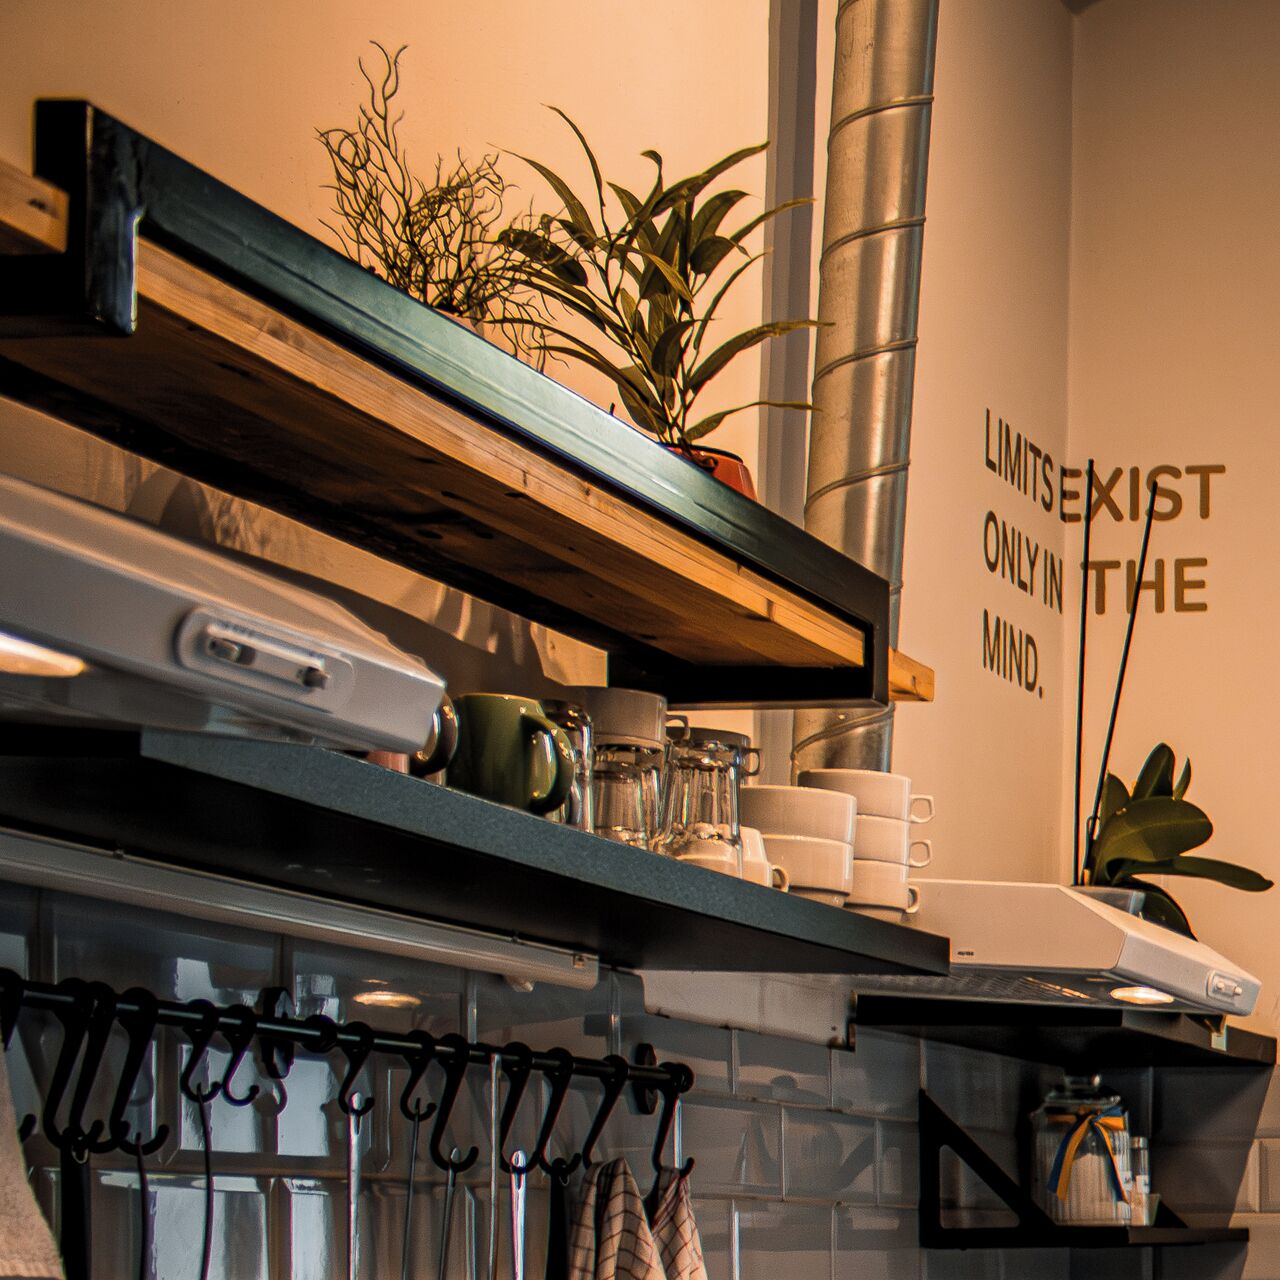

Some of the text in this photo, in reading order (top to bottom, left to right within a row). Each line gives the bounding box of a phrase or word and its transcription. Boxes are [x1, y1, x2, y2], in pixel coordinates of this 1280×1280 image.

[985, 408, 1226, 522] LIMITS EXIST
[983, 510, 1208, 615] ONLY IN THE
[983, 608, 1043, 699] MIND.
